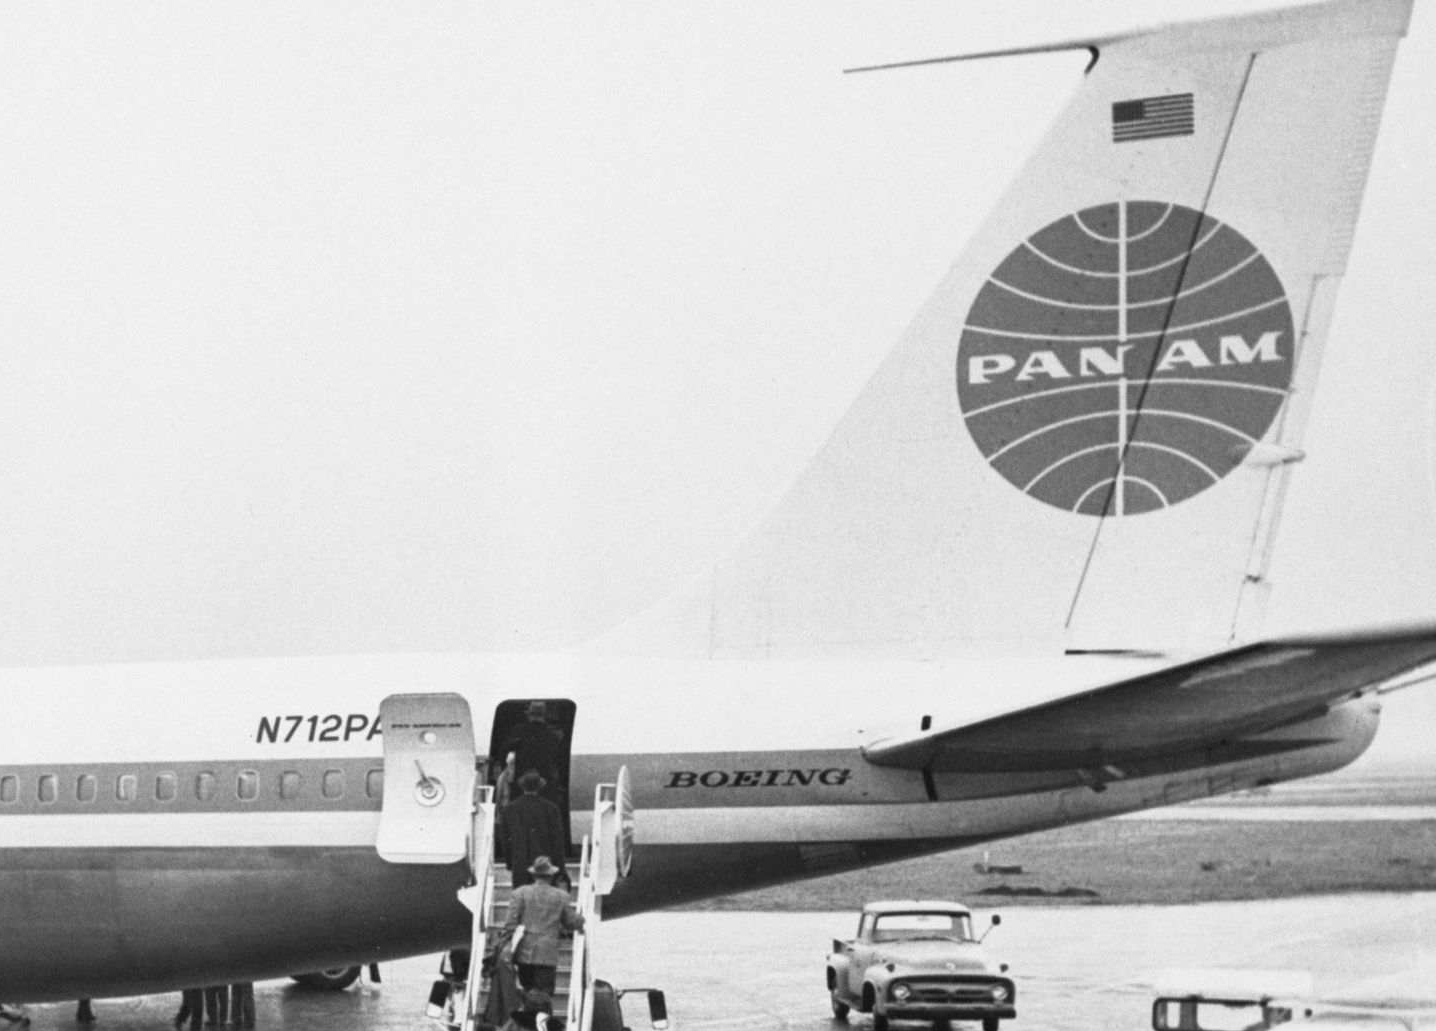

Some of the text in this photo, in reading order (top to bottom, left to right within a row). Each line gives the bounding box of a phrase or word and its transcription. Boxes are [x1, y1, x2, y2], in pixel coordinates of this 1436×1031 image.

[968, 330, 1286, 385] PAN AM
[663, 767, 853, 789] BOEING
